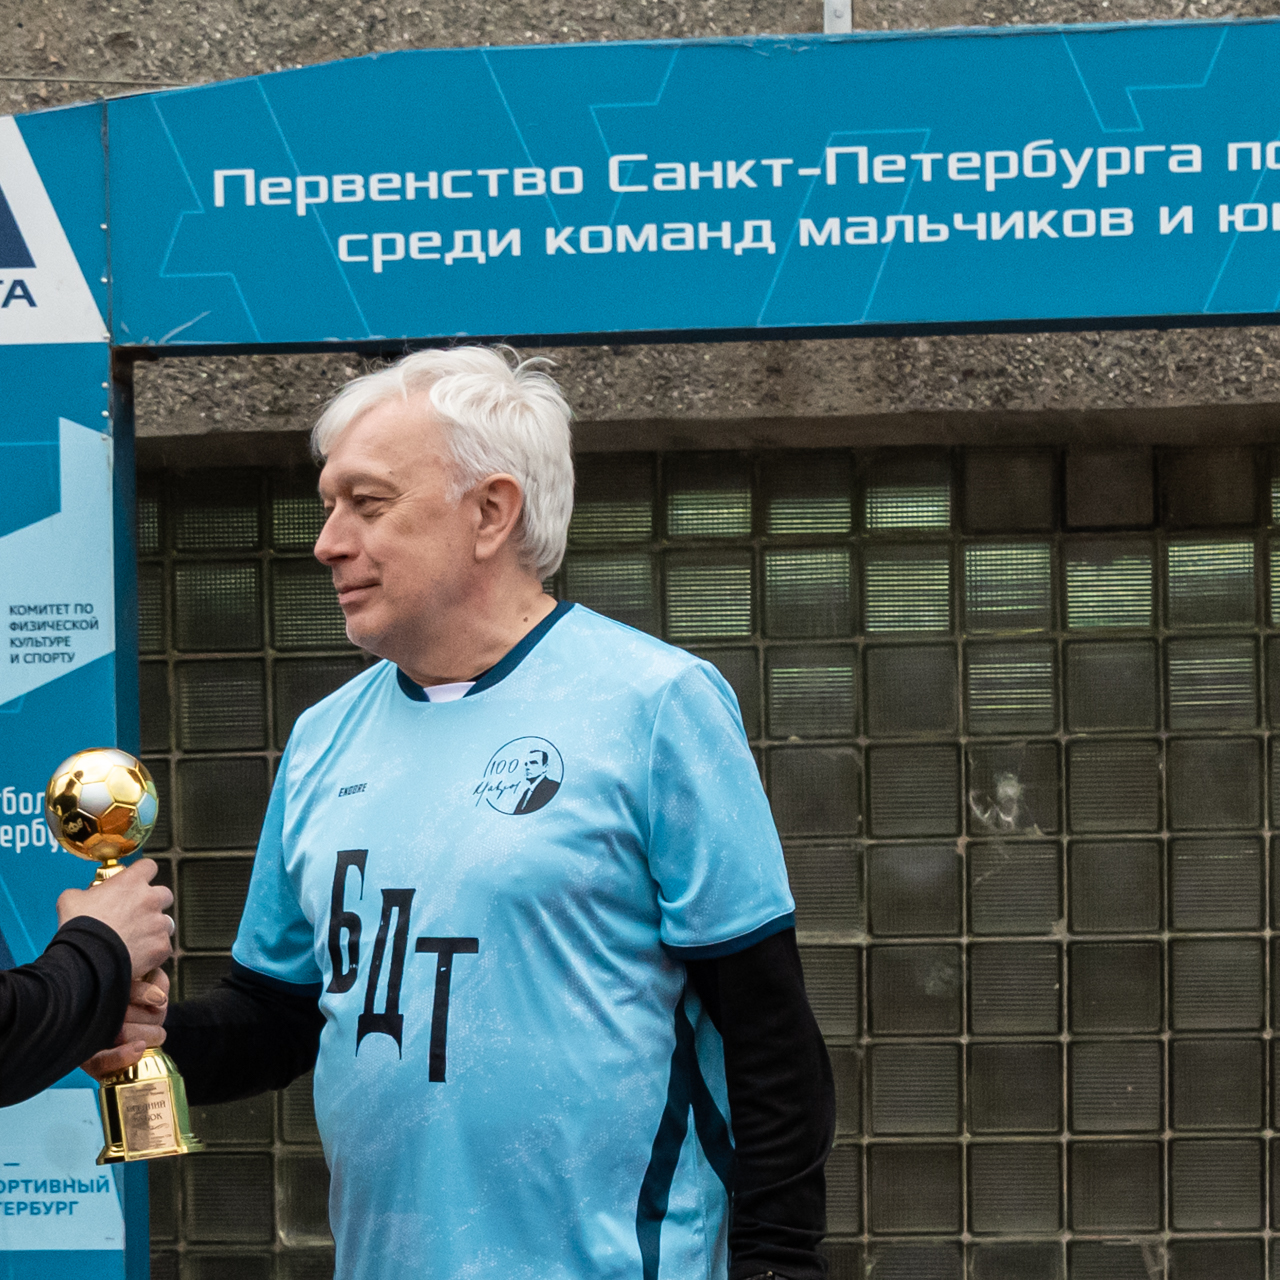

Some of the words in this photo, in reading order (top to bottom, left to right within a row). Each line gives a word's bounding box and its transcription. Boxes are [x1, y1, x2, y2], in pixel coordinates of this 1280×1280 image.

[213, 164, 585, 217] Первенство
[607, 139, 1203, 192] Санкт-Петербурга
[337, 226, 522, 274] среди
[545, 219, 777, 256] команд
[798, 206, 1135, 248] мальчиков
[1159, 206, 1195, 235] и
[9, 604, 70, 616] КОМИТЕТ
[73, 603, 94, 614] ПО
[9, 617, 99, 632] ФИЗИЧЕСКОЙ
[10, 636, 71, 648] КУЛЬТУРЕ
[10, 653, 20, 664] И
[23, 652, 76, 664] СПОРТУ
[490, 759, 520, 776] 100
[326, 849, 480, 1083] БДТ
